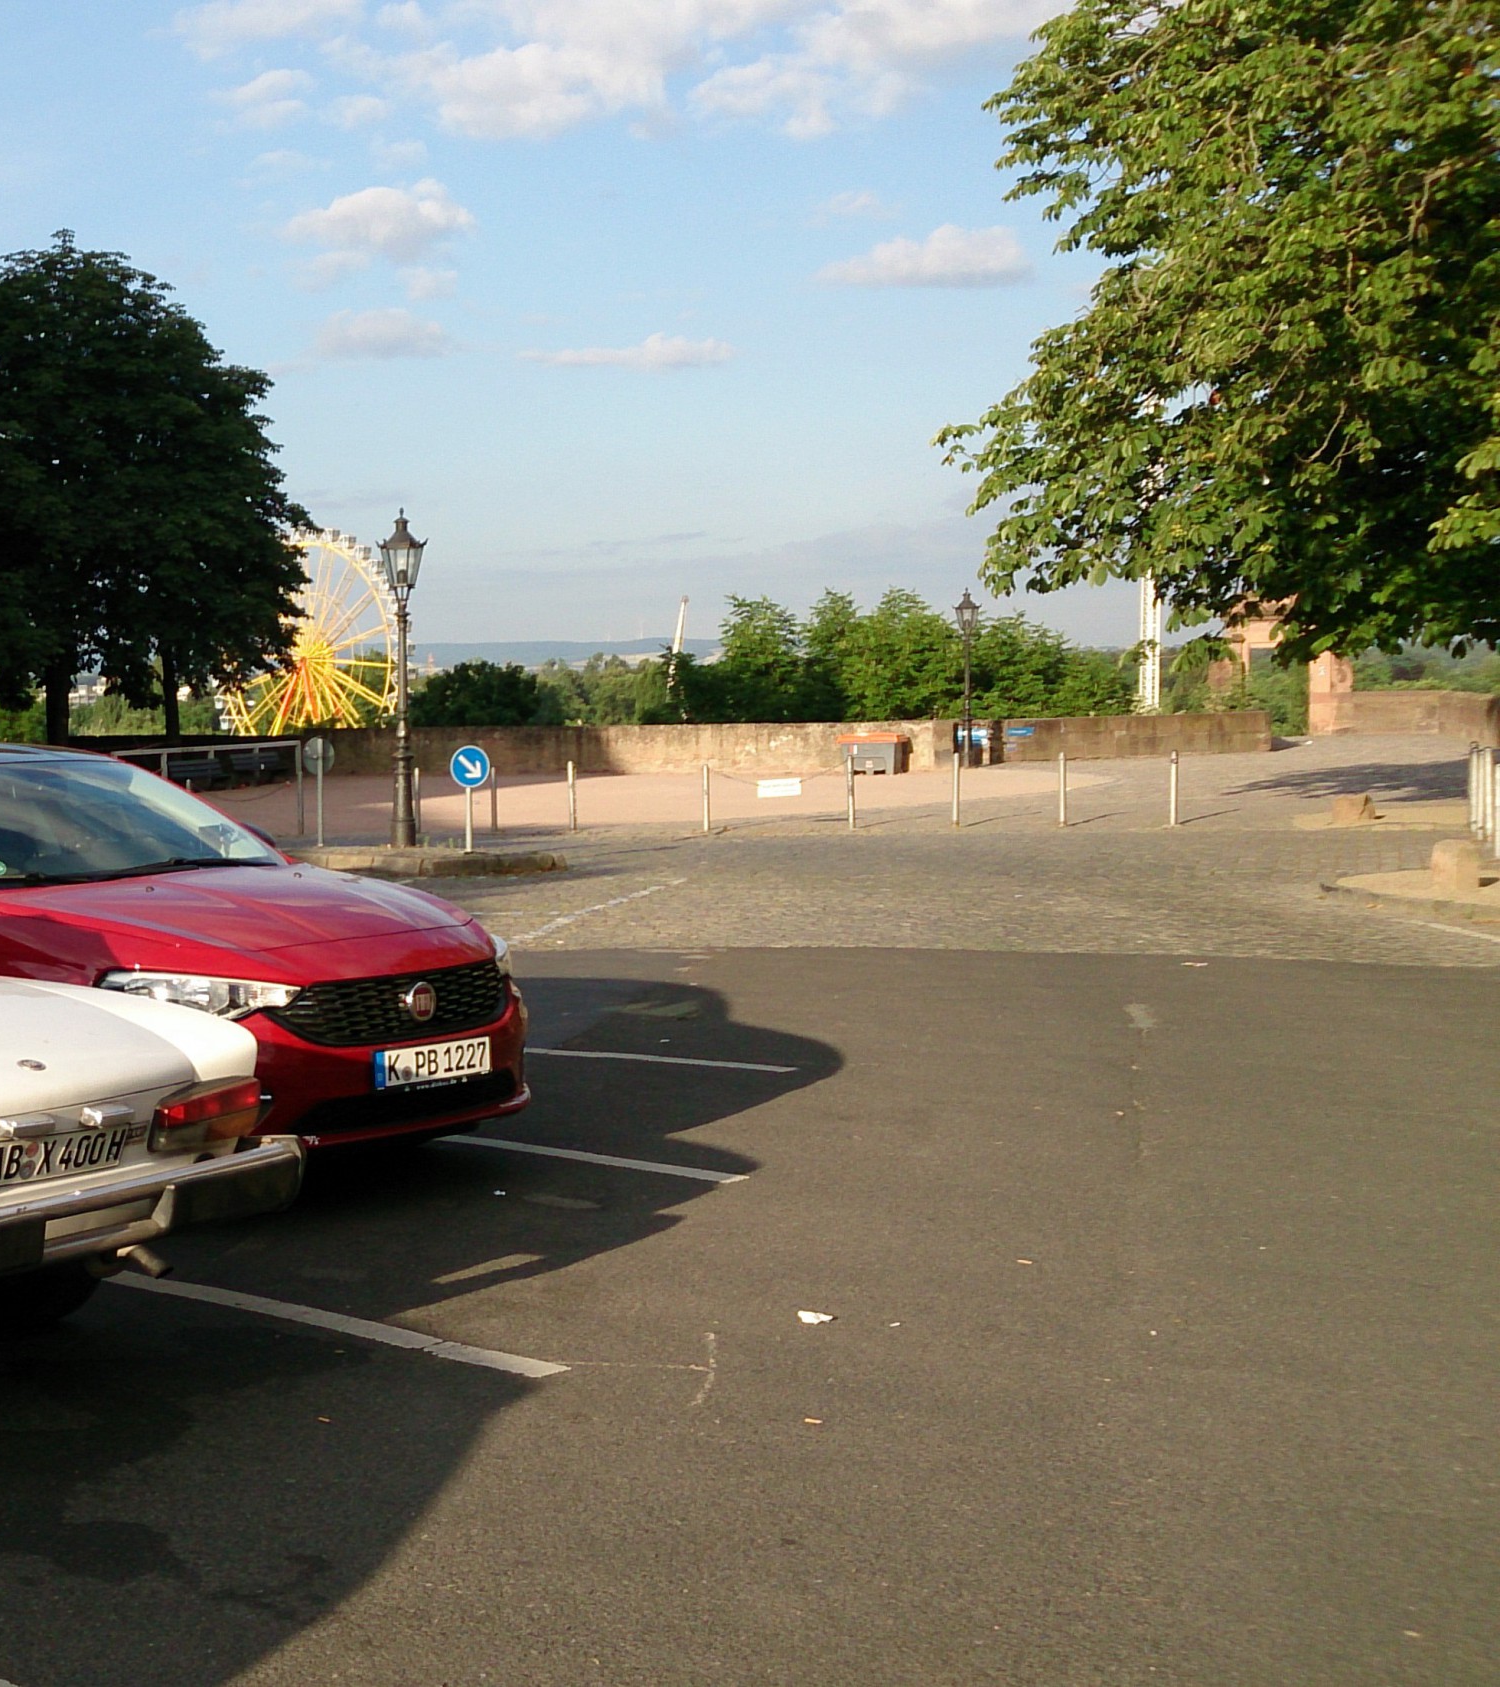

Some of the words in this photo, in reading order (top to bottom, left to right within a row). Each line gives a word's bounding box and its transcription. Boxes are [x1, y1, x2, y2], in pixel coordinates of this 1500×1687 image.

[388, 1054, 400, 1081] K
[415, 1049, 439, 1077] PB
[444, 1041, 486, 1073] 1227
[37, 1141, 56, 1175] X
